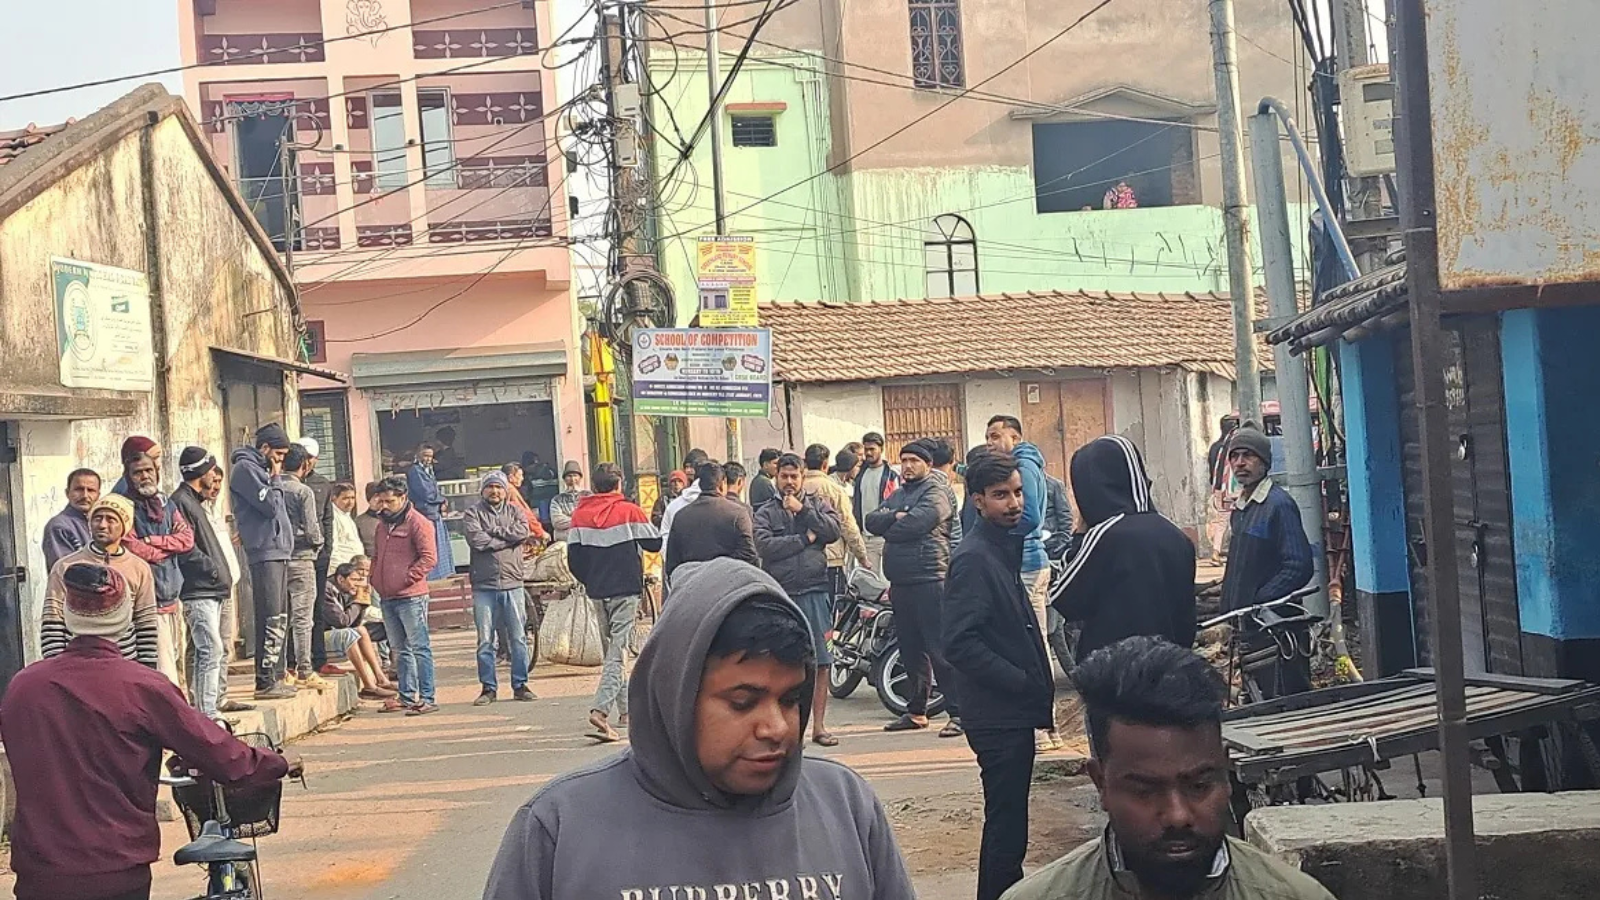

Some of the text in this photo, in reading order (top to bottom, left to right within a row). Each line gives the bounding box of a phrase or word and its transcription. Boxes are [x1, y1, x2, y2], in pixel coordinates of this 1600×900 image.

[654, 333, 758, 347] SCHOOL OF COMPETITION
